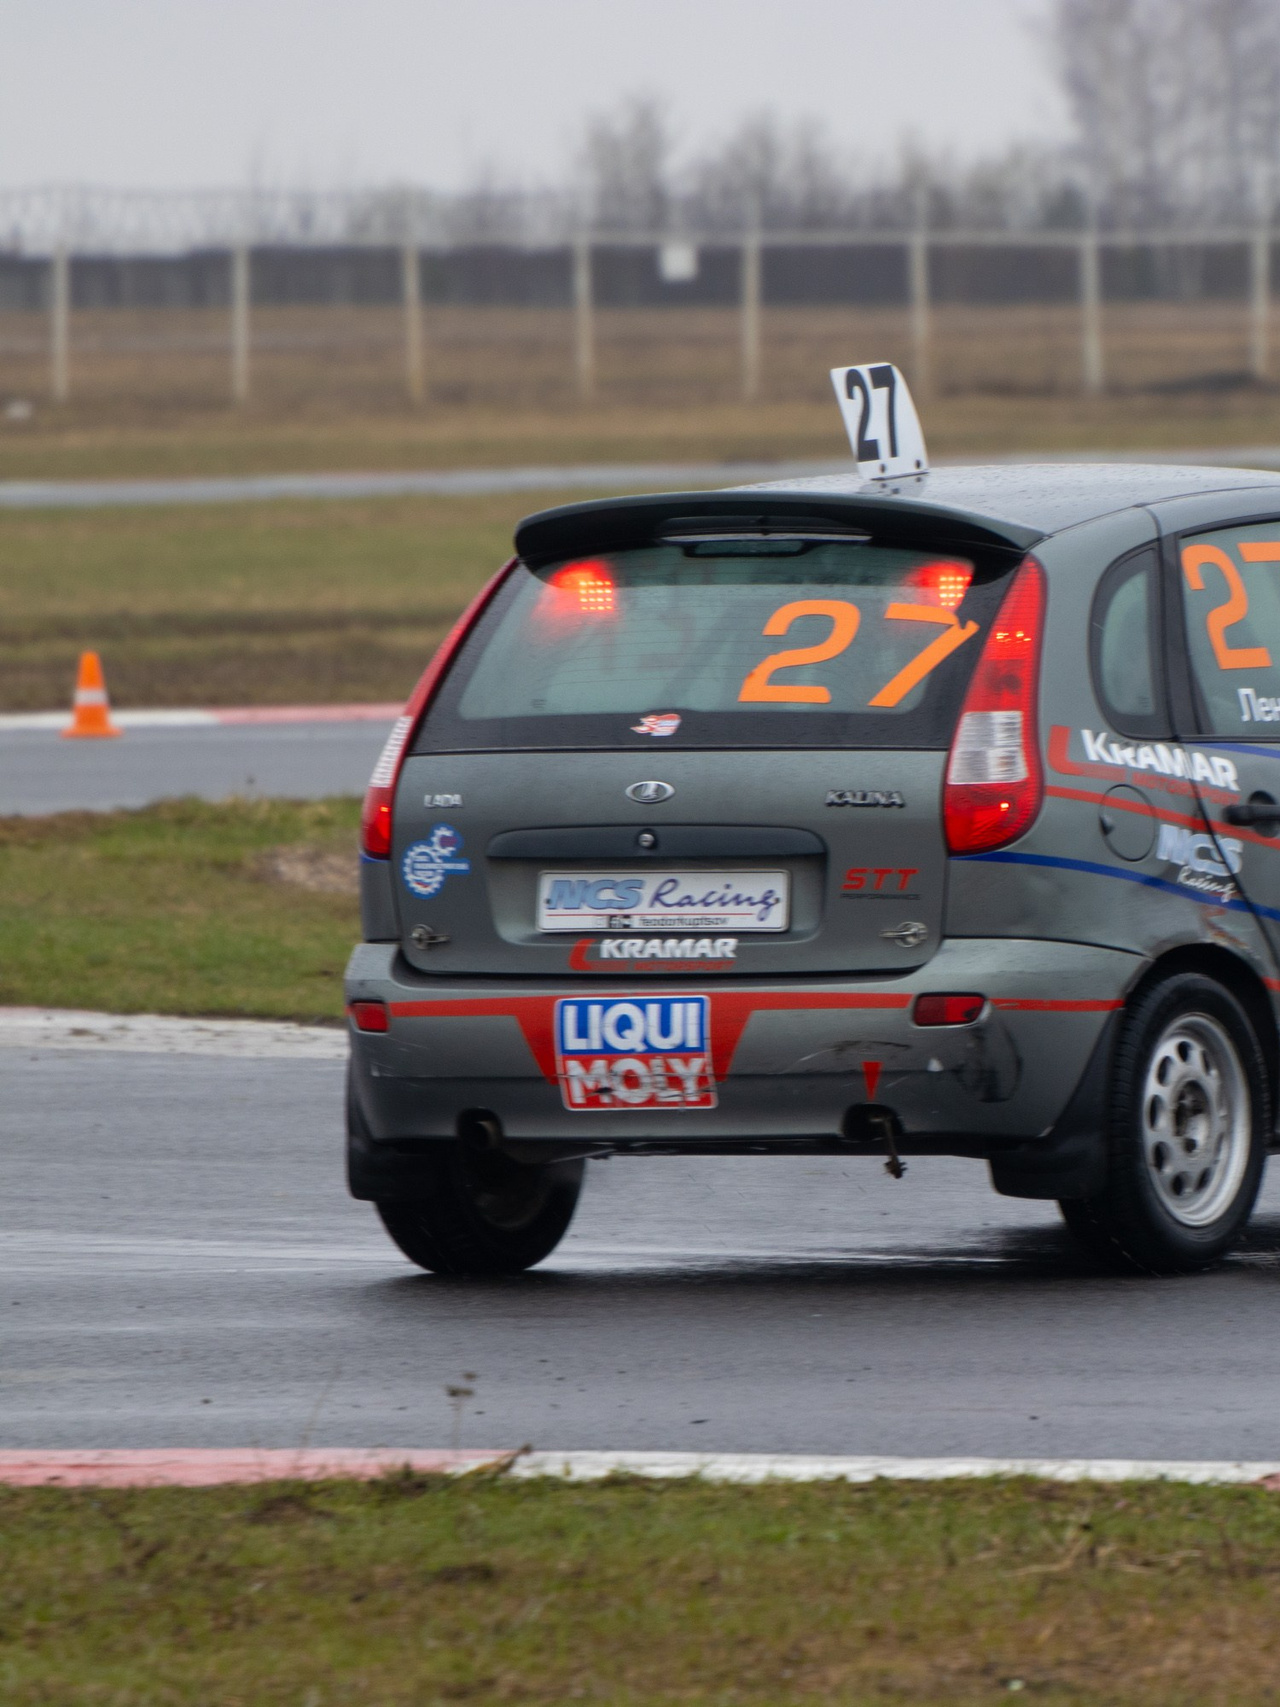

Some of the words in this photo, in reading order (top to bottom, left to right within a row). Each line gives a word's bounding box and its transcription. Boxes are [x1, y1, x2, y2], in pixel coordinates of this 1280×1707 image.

[845, 365, 899, 462] 27
[737, 599, 980, 708] 27
[1081, 729, 1241, 791] KRAMAR
[424, 794, 463, 808] LADA
[825, 789, 905, 808] KALINA
[1155, 824, 1243, 877] NCS
[547, 878, 645, 910] NCS
[649, 878, 780, 922] Racing
[841, 867, 920, 890] STT
[1177, 865, 1240, 903] Racing
[600, 938, 739, 959] KRAMAR
[563, 1002, 701, 1052] LIQUI
[565, 1056, 707, 1104] MOLY
